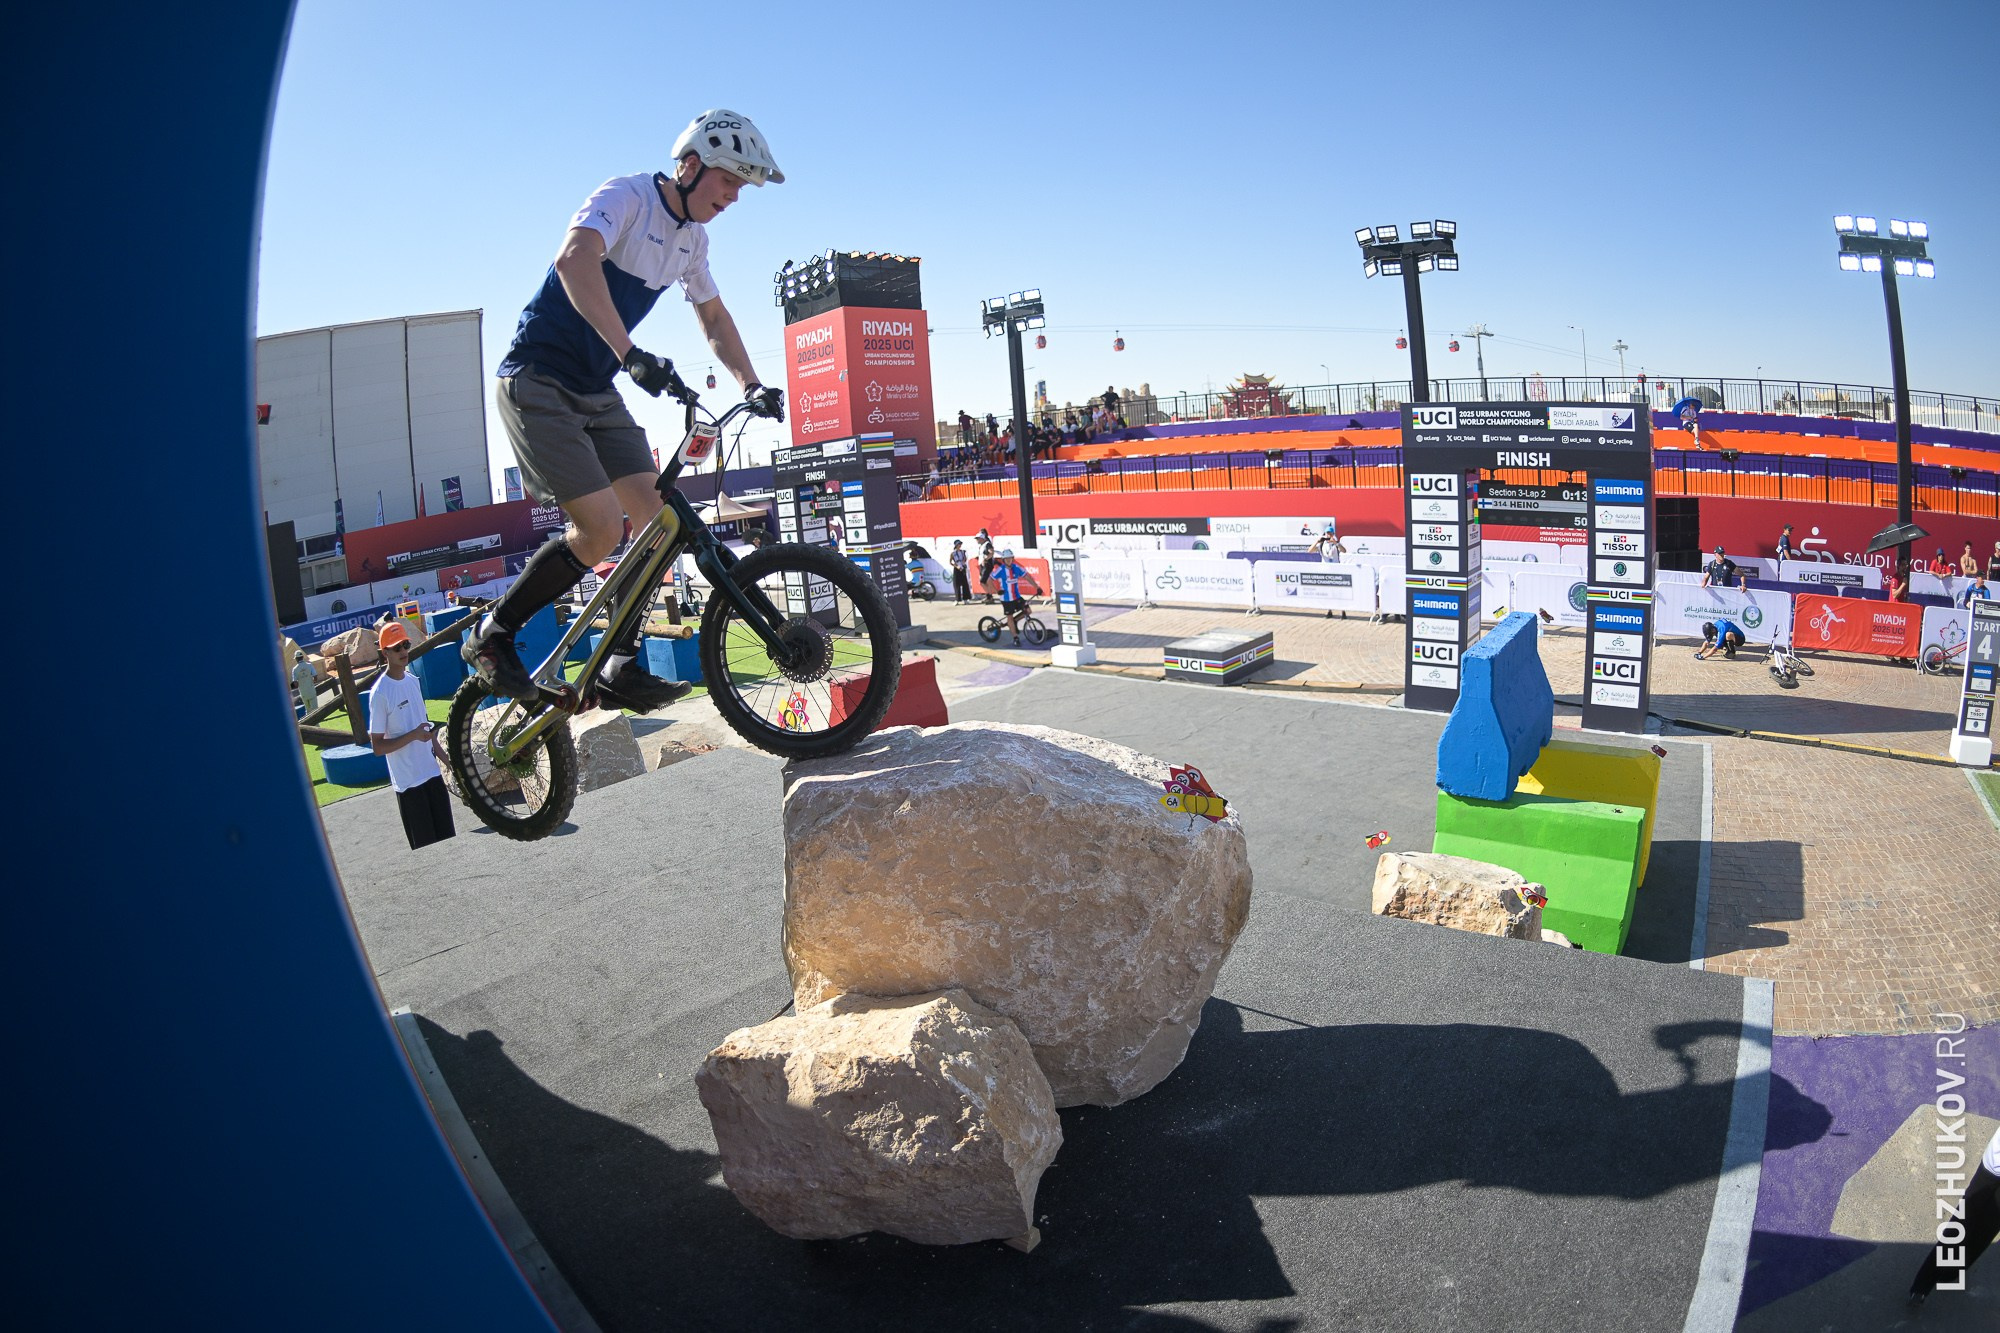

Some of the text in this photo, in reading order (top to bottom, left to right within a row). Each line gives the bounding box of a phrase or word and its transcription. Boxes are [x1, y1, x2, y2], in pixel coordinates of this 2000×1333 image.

[862, 320, 913, 336] RIYADH
[796, 326, 833, 350] RIYADH
[864, 339, 914, 351] 2025 UCI
[797, 344, 834, 363] 2025 UCI
[798, 364, 835, 379] CHAMPIONSHIPS
[1420, 411, 1453, 425] UCI
[778, 453, 790, 462] UCI
[1497, 451, 1551, 467] FINISH
[805, 470, 826, 481] FINISH
[1421, 478, 1453, 492] UCI
[780, 491, 792, 500] UCI
[1489, 488, 1546, 498] Section 3-Lap 2
[1562, 490, 1587, 501] 0:13
[1596, 486, 1643, 496] SHIMANO
[1510, 501, 1540, 509] HEINO
[532, 512, 560, 523] 2025 UCI
[1574, 517, 1588, 526] 50
[1093, 524, 1113, 533] 2025
[1114, 523, 1145, 533] URBAN
[1146, 523, 1188, 533] CYCLING
[1216, 523, 1251, 533] RIYADH
[1602, 542, 1638, 551] TISSOT
[1843, 552, 1890, 569] SAUDI
[1054, 563, 1075, 571] START
[1062, 571, 1074, 591] 3
[1211, 577, 1244, 585] CYCLING
[1280, 574, 1299, 583] UCI
[1427, 579, 1446, 587] UCI
[1803, 574, 1820, 582] UCI
[791, 588, 803, 597] UCI
[814, 585, 831, 595] UCI
[1610, 590, 1630, 600] UCI
[1414, 600, 1459, 610] SHIMANO
[1595, 613, 1643, 625] SHIMANO
[1873, 613, 1906, 626] RIYADH
[312, 613, 376, 638] SHIMANO
[1872, 625, 1906, 635] 2025 UCI
[1973, 621, 2000, 633] START
[1977, 634, 1992, 660] 4
[1241, 649, 1255, 664] UCI
[1422, 646, 1453, 661] UCI
[1180, 659, 1202, 671] UCI
[1602, 662, 1636, 679] UCI
[1166, 797, 1178, 807] 6A
